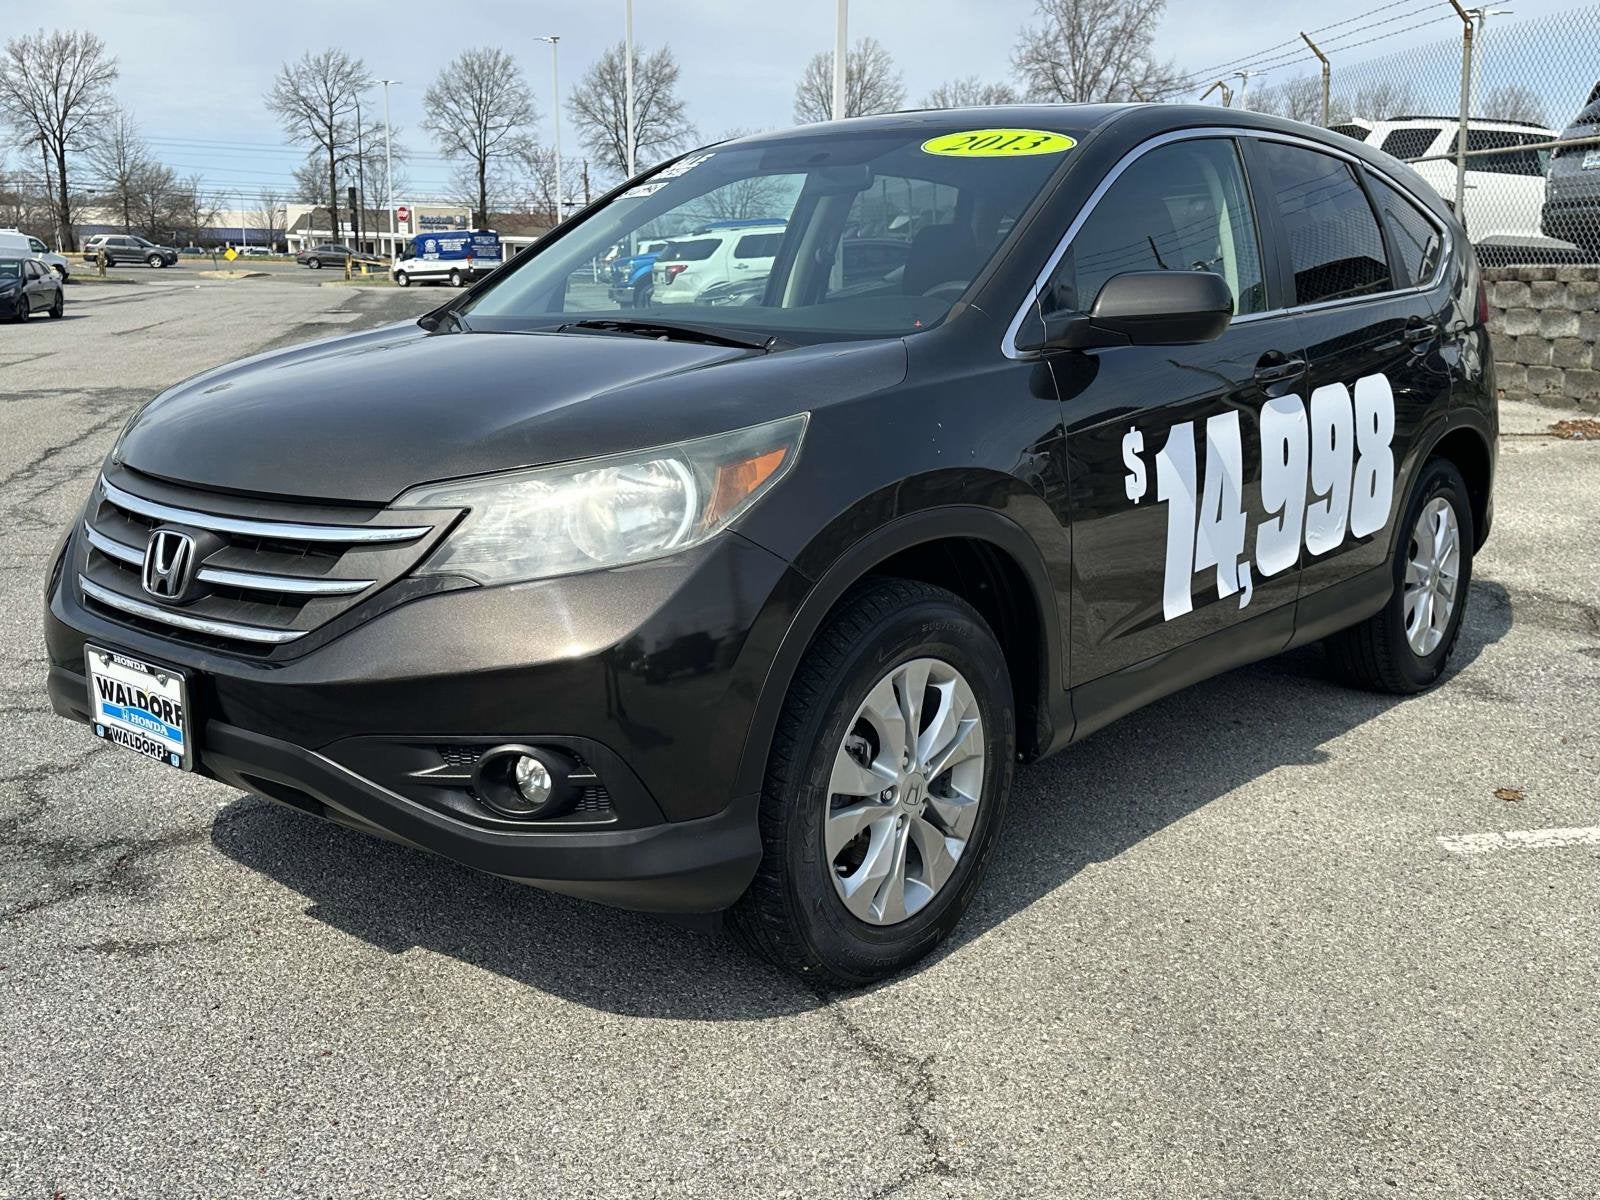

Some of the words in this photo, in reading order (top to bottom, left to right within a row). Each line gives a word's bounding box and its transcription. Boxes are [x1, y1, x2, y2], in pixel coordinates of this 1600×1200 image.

[941, 135, 1052, 151] 2013
[112, 654, 149, 673] HONDA
[95, 676, 182, 728] WALDORF
[130, 713, 169, 736] HONDA
[111, 726, 163, 760] WALDORF
